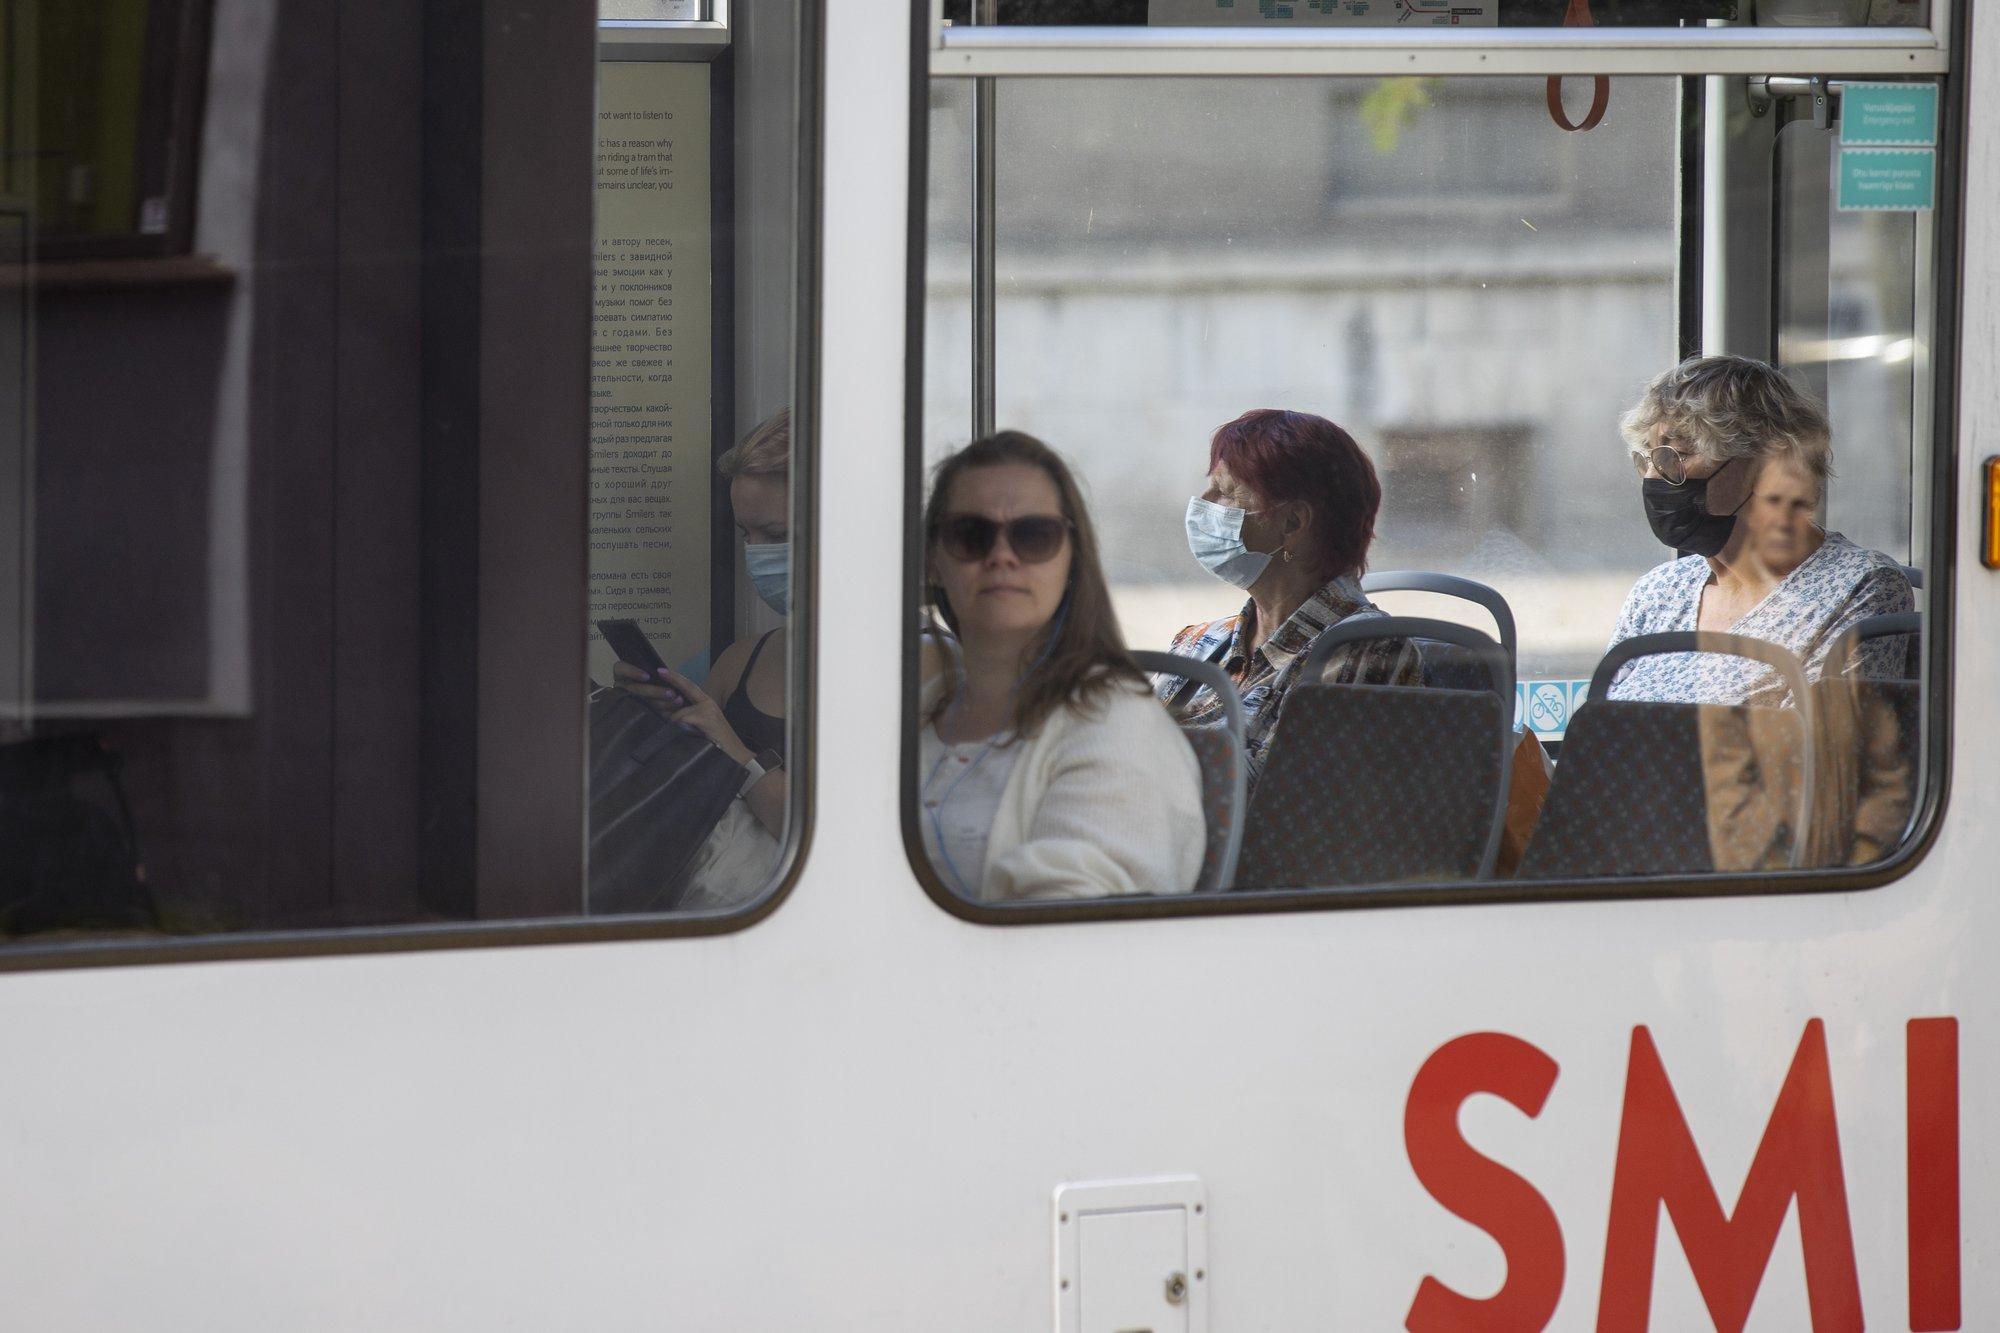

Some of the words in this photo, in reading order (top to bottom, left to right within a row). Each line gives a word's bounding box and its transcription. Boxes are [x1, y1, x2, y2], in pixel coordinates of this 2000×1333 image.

[643, 111, 663, 119] listen
[607, 138, 620, 147] has
[657, 139, 673, 150] why
[608, 153, 630, 163] riding
[658, 153, 672, 161] that
[627, 181, 657, 191] unclear,
[658, 182, 673, 191] you
[612, 238, 641, 247] автору
[646, 239, 672, 247] песен,
[629, 252, 672, 262] завидной
[613, 269, 645, 277] эмоции
[667, 269, 672, 278] у
[611, 284, 616, 293] у
[658, 297, 672, 306] без
[612, 329, 650, 338] годами.
[656, 327, 672, 336] Без
[626, 345, 672, 353] творчество
[648, 374, 672, 382] когда
[616, 436, 629, 444] раз
[630, 435, 672, 444] предлагая
[623, 450, 657, 459] доходит
[641, 464, 672, 475] Слушая
[605, 479, 646, 490] хороший
[651, 481, 672, 489] друг
[610, 496, 625, 504] для
[625, 509, 655, 519] Smilers
[609, 602, 671, 612] переосмыслить
